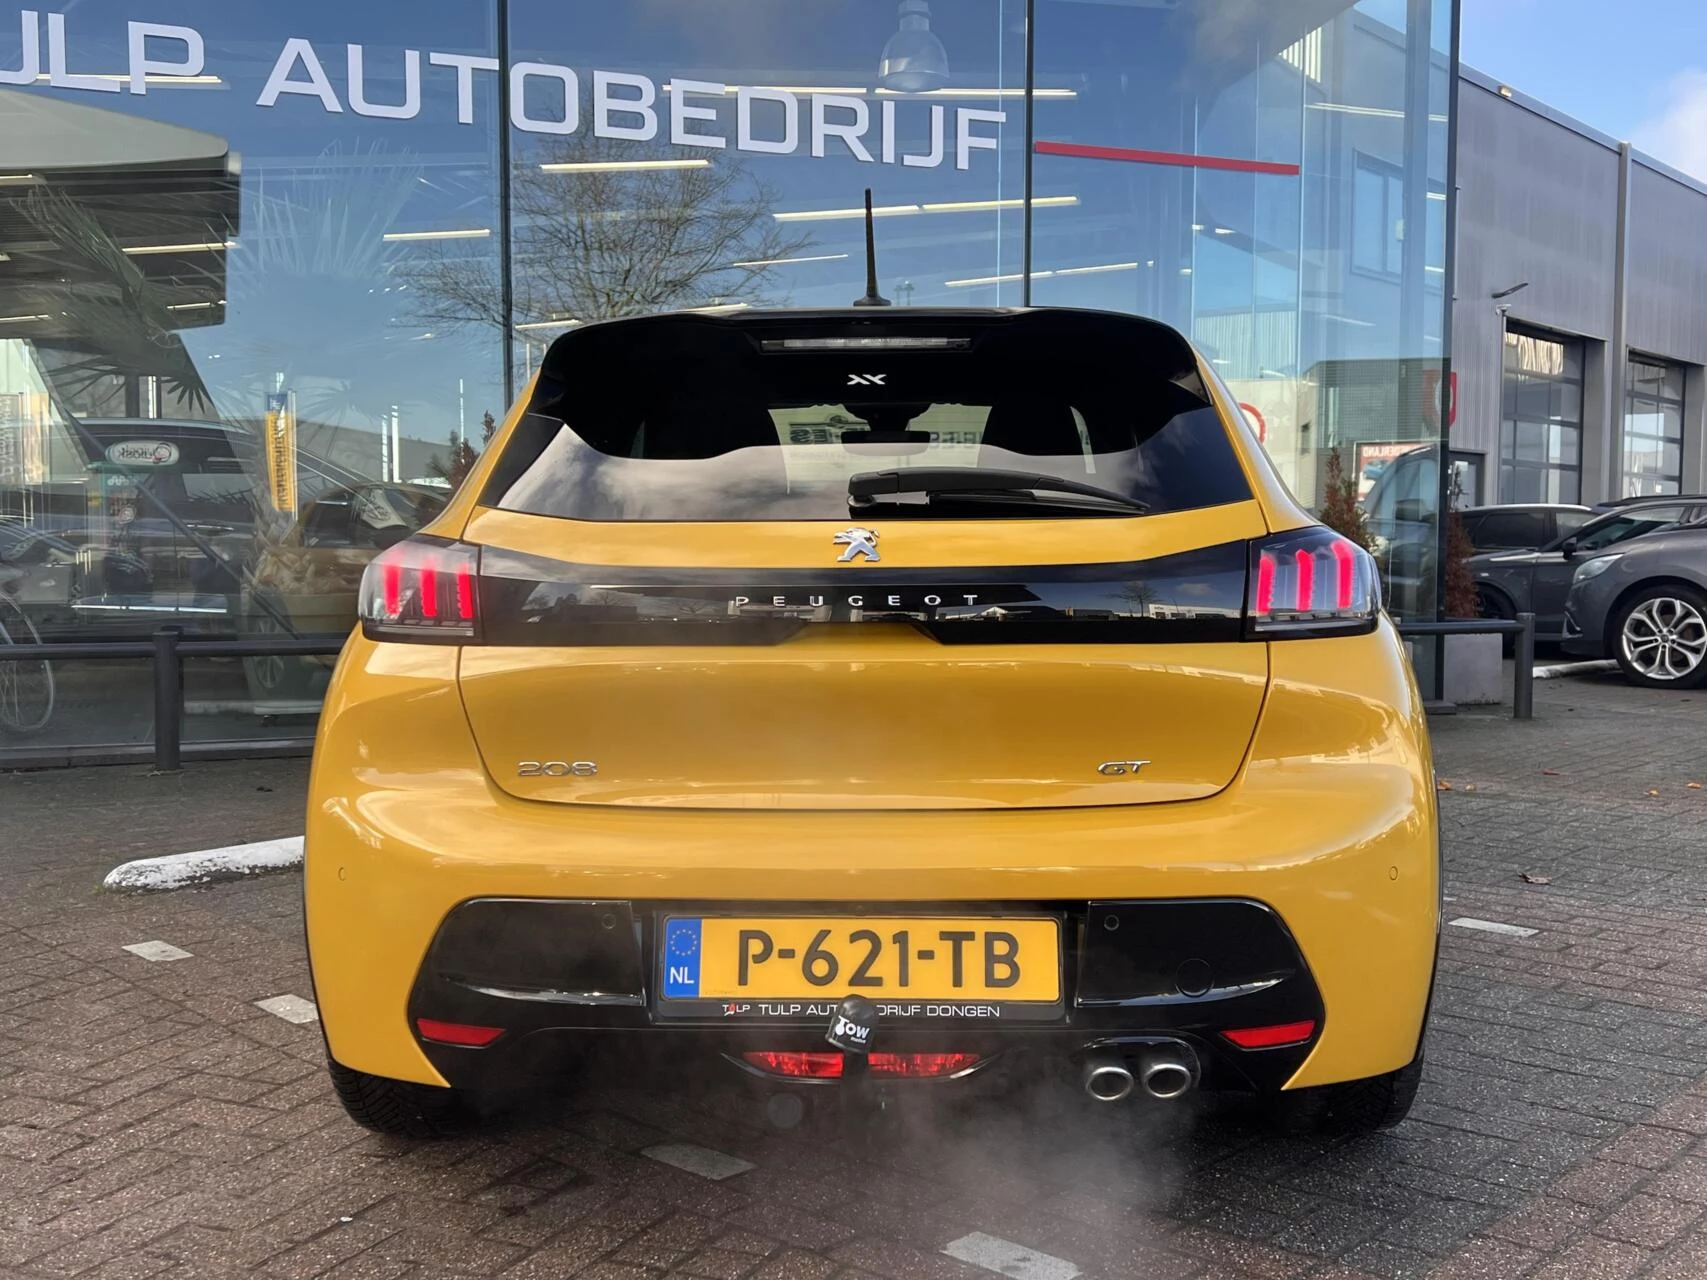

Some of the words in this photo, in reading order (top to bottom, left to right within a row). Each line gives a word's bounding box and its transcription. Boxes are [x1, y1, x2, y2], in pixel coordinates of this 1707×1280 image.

[256, 38, 1006, 170] AUTOBEDRIJF
[735, 594, 978, 607] PEUGEOT
[518, 761, 598, 776] 208
[1098, 760, 1151, 775] GT
[738, 929, 1020, 988] P-621-TB
[670, 966, 694, 984] NL
[758, 1004, 801, 1015] TULP
[806, 1004, 921, 1016] AUTDRIJF
[927, 1005, 1000, 1017] DONGEN
